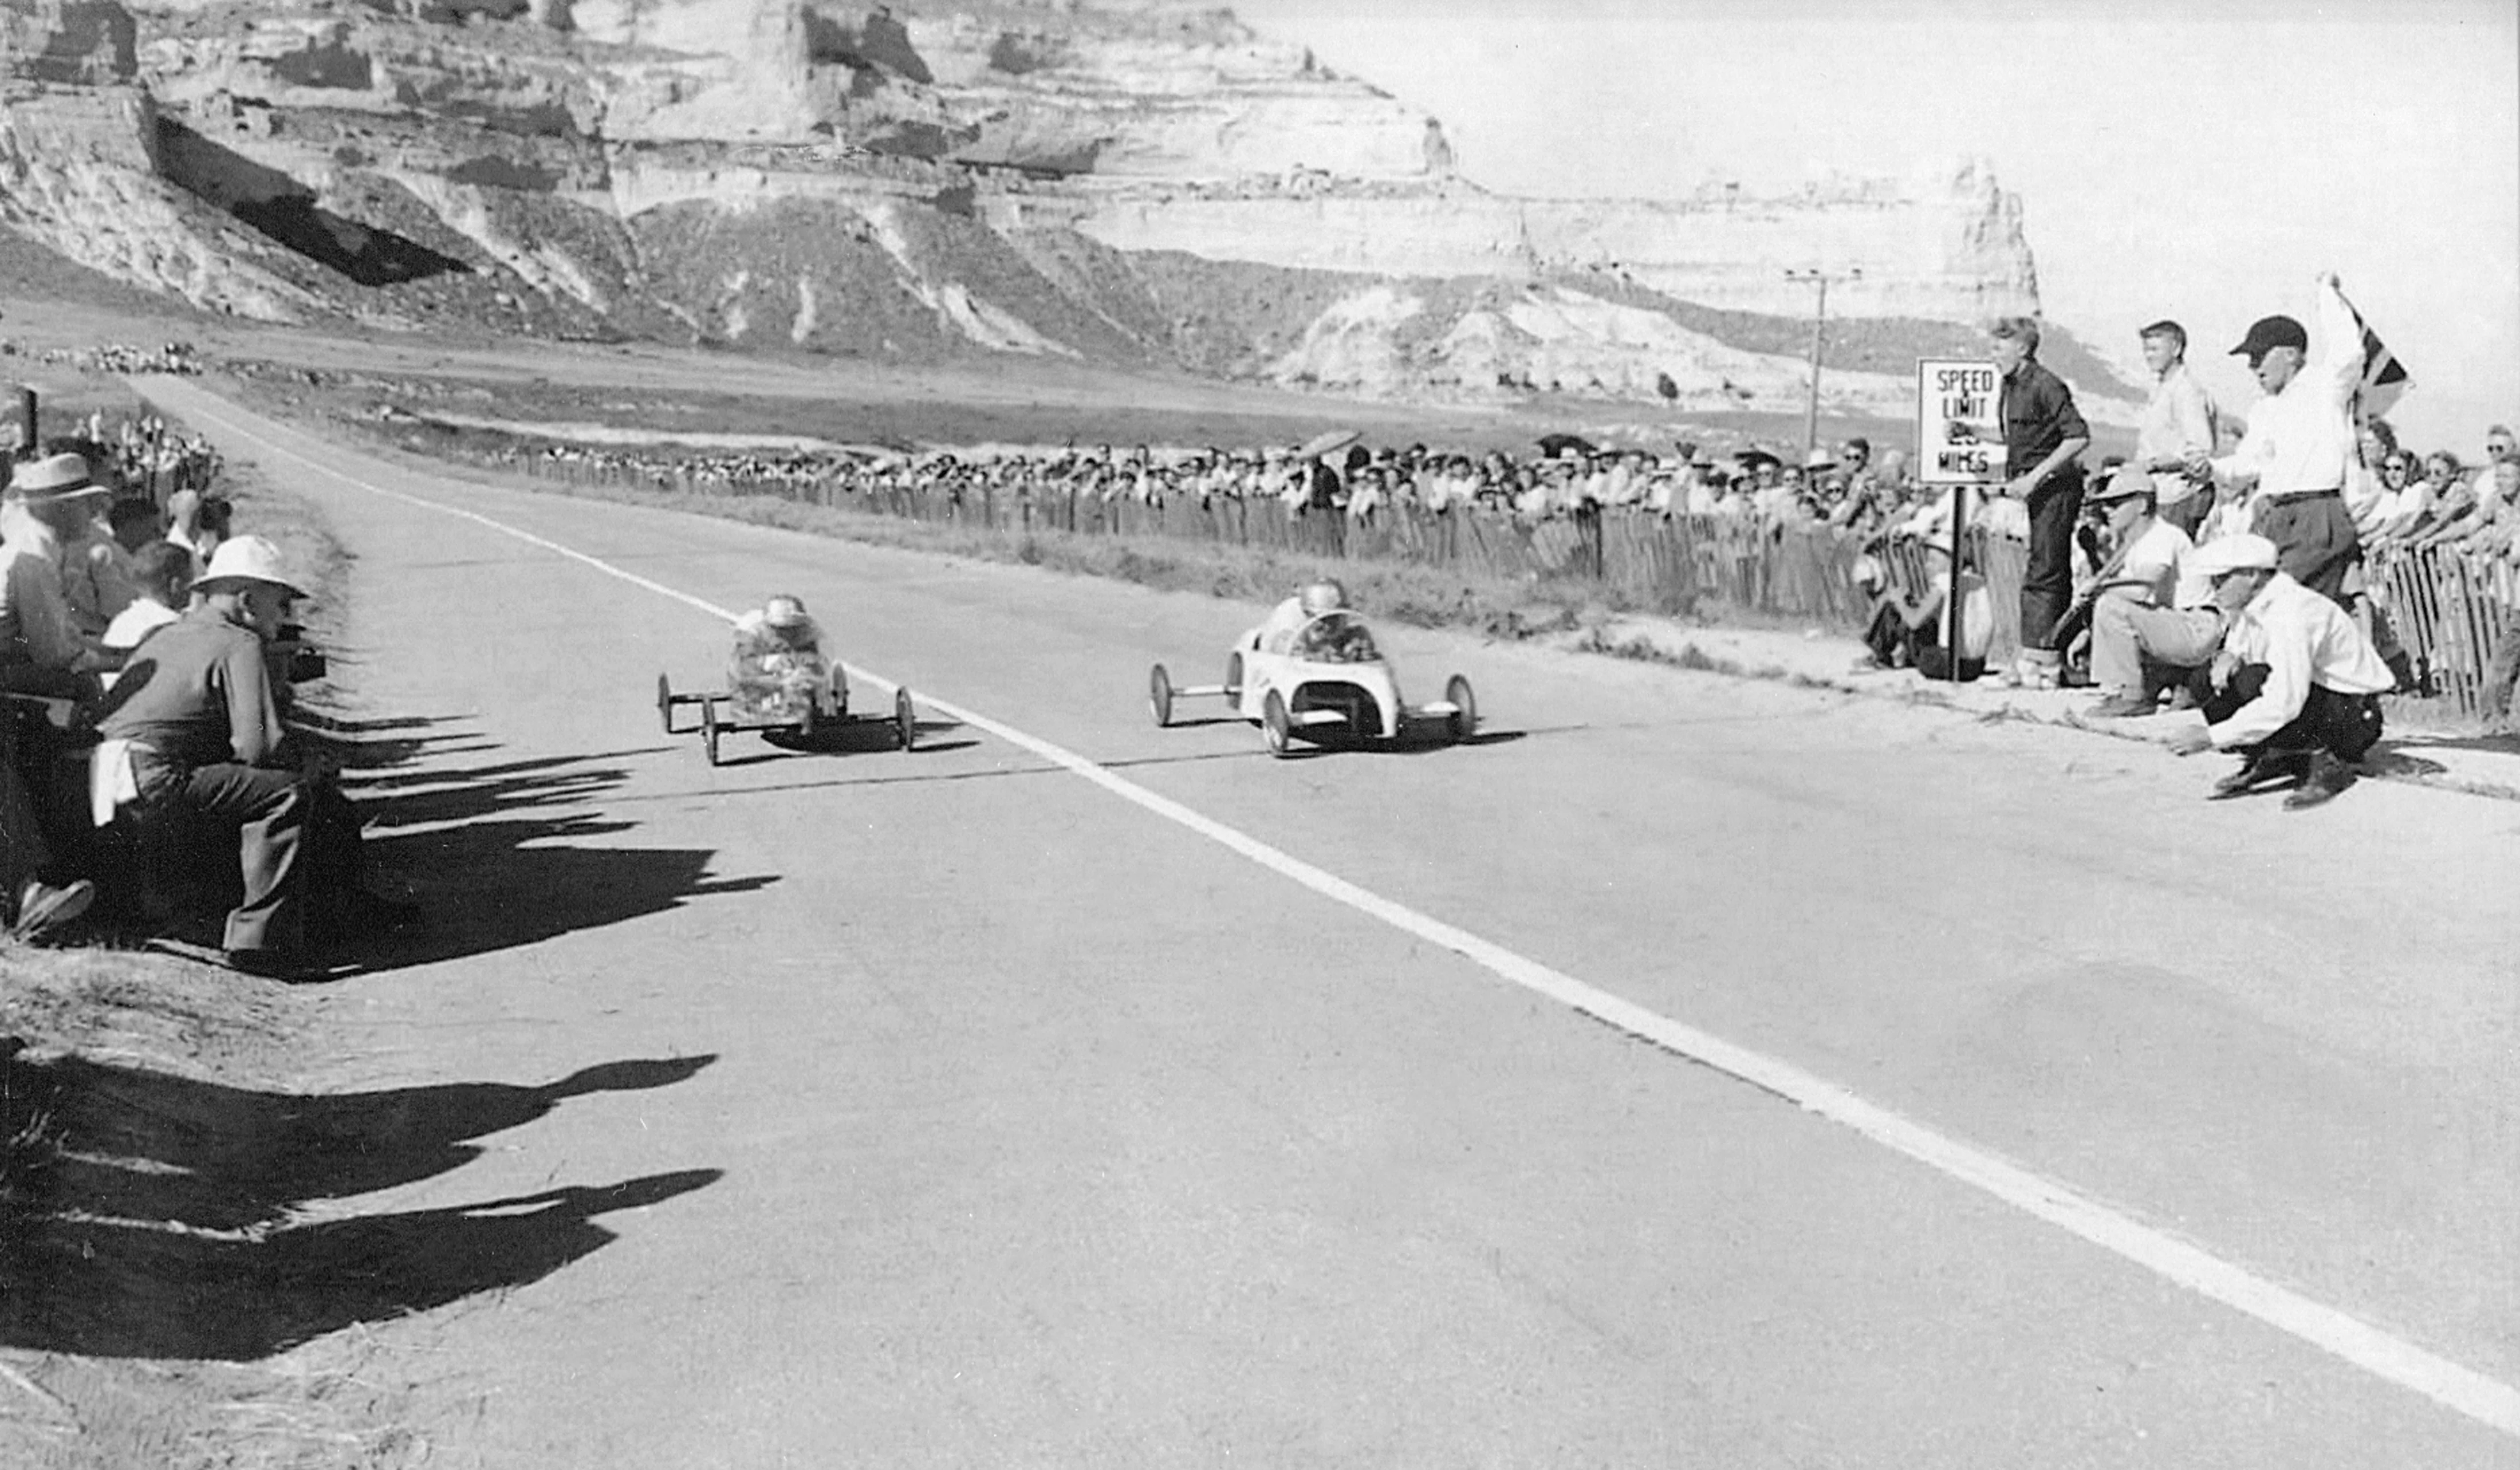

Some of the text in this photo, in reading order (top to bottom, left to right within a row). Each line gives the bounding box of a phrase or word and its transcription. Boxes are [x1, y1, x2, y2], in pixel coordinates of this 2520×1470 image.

[1938, 369, 1993, 392] SPEED
[1943, 398, 1986, 419] LIMIT
[1939, 451, 1988, 472] MILES
